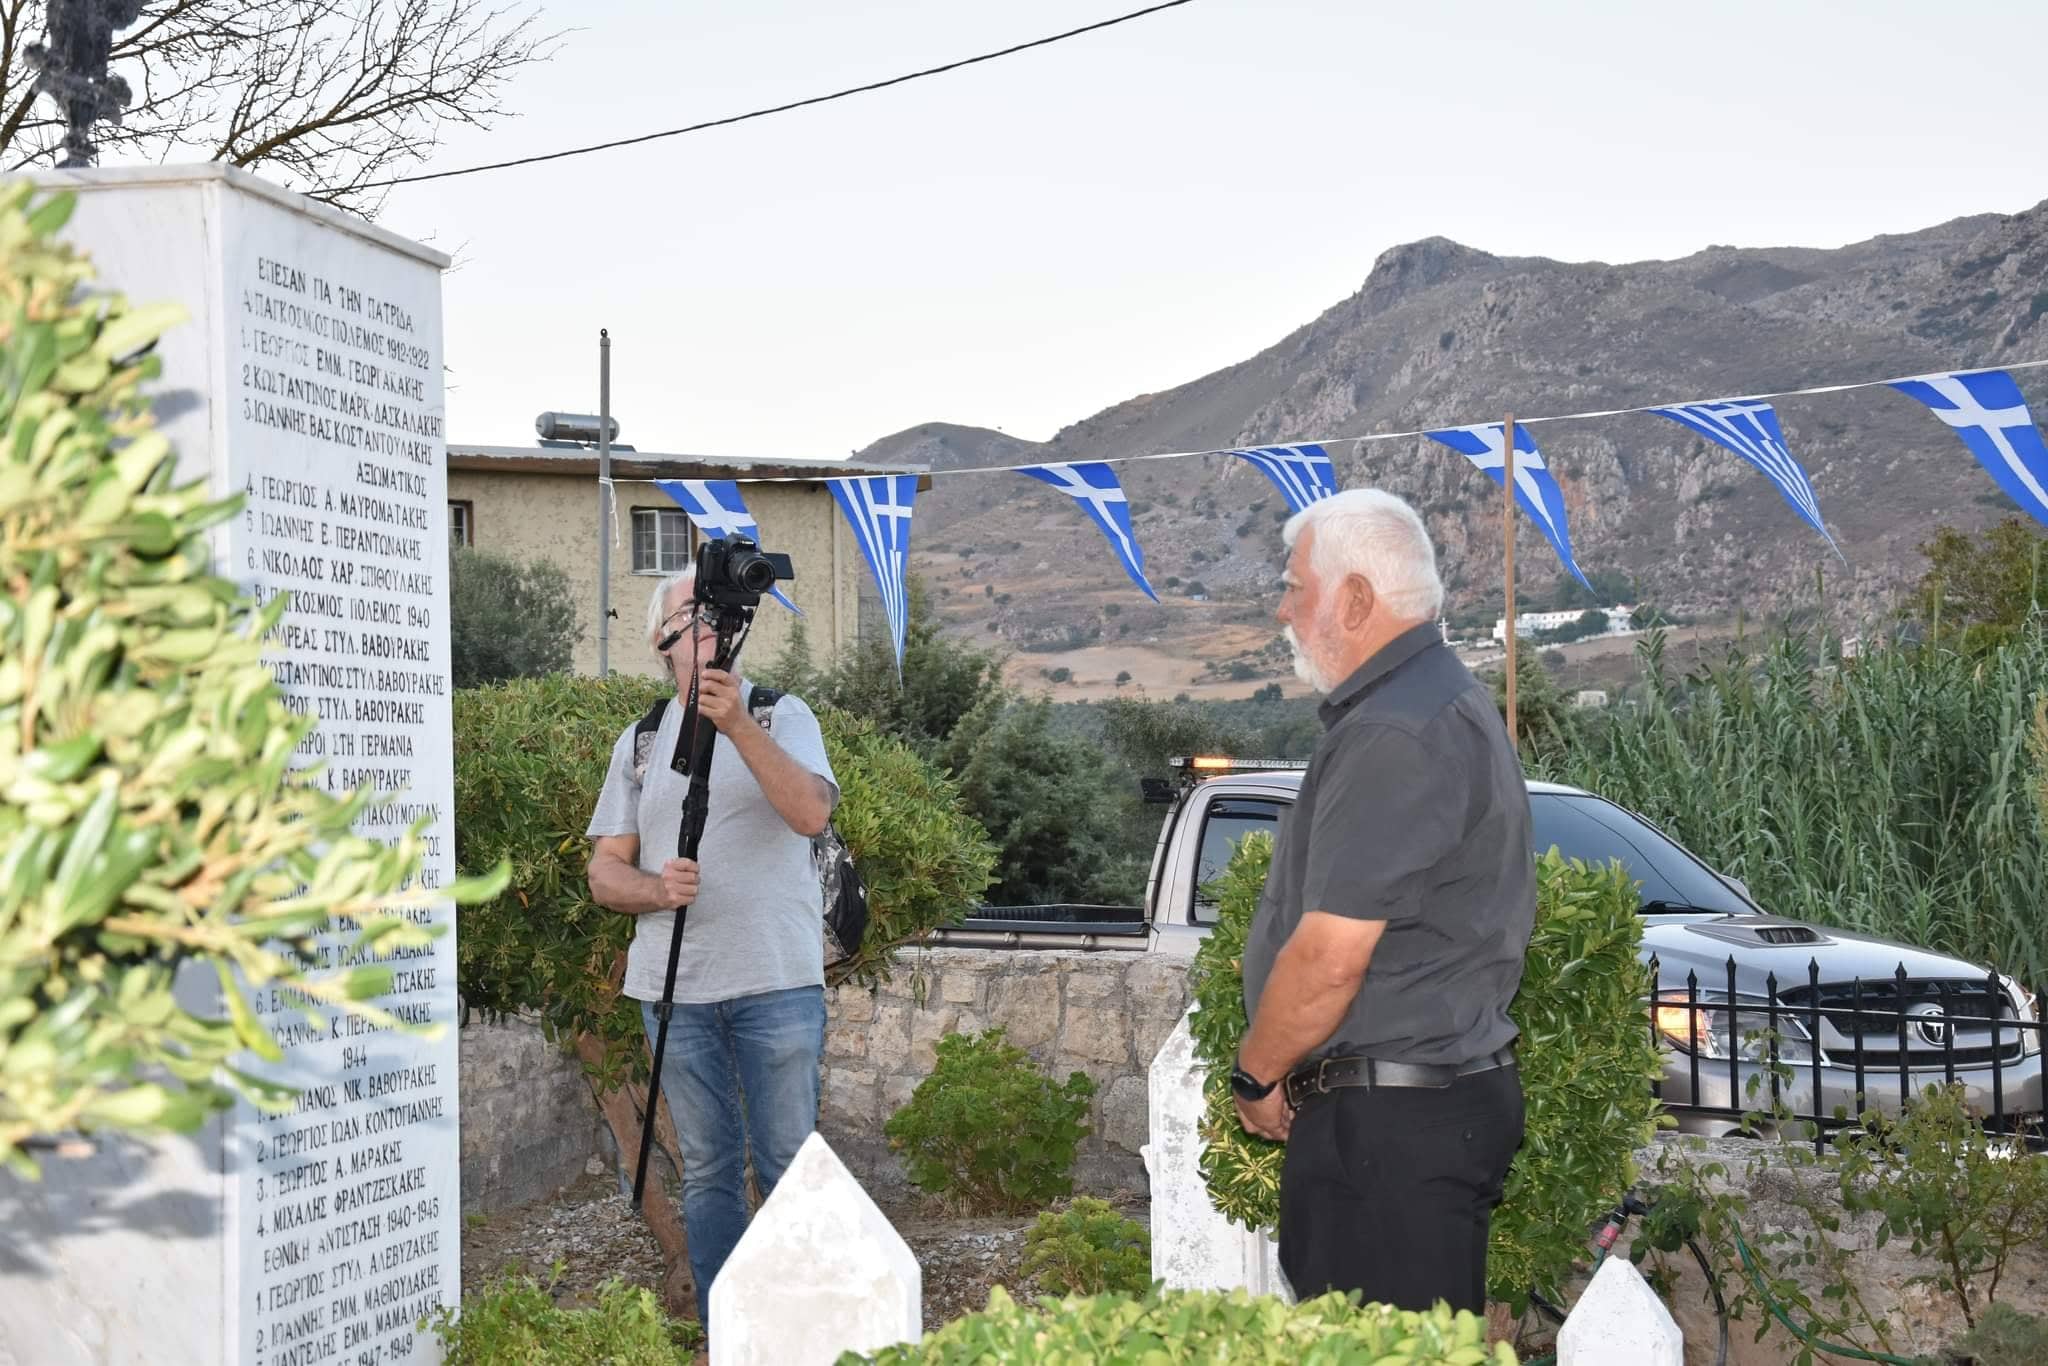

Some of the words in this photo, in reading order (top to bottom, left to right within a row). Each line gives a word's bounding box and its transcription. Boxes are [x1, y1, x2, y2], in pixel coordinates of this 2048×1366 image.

[258, 256, 306, 294] ΕΠΕΣΑΝ
[313, 277, 332, 305] ΓΙΑ
[338, 286, 361, 313] ΤΗΝ
[331, 318, 385, 356] ΠΟΛΕΜΟΣ
[316, 347, 346, 377] ΕΜΜ.
[356, 461, 427, 499] ΑΞΙΩΜΑΤΙΚΟΣ
[262, 475, 318, 509] ΓΕΩΡΓΙΟΣ
[340, 491, 429, 531] ΜΑΥΡΟΜΑΤΑΚΗΣ
[261, 511, 315, 543] ΙΩΑΝΝΗΣ
[321, 521, 333, 545] Ε.
[335, 525, 422, 561] ΠΕΡΑΝΤΩΝΑΚΗΣ
[262, 549, 325, 580] ΝΙΚΟΛΑΟΣ
[350, 597, 401, 625] ΠΟΛΕΜΟΣ
[407, 605, 430, 629] 1940
[324, 630, 359, 656] ΣΤΥΛ.
[361, 632, 430, 662] ΒΑΒΟΥΡΑΚΗΣ
[378, 669, 445, 696] ΒΑΒΟΥΡΑΚΗΣ
[317, 697, 352, 721] ΣΤΥΛ.
[355, 698, 425, 724] ΒΑΒΟΥΡΑΚΗΣ
[332, 733, 354, 757] ΣΤΗ
[361, 733, 414, 758] ΓΕΡΜΑΝΙΑ
[343, 1043, 367, 1070] 1944
[344, 1078, 366, 1104] ΝΙΚ.
[369, 1063, 437, 1098] ΒΑΒΟΥΡΑΚΗΣ
[257, 1139, 269, 1163] 2.
[272, 1123, 328, 1160] ΓΕΩΡΓΙΟΣ
[332, 1115, 363, 1144] ΙΩΑΝ.
[365, 1096, 443, 1136] ΚΟΝΤΟΓΙΑΝΝΗΣ
[272, 1160, 328, 1199] ΓΕΩΡΓΙΟΣ
[335, 1156, 348, 1180] Α.
[351, 1140, 402, 1175] ΜΑΡΑΚΗΣ
[257, 1213, 269, 1238] 4.
[273, 1196, 327, 1233] ΜΙΧΑΛΗΣ
[334, 1166, 426, 1215] ΦΡΑΝΤΖΕΣΚΑΚΗΣ
[264, 1237, 310, 1274] ΕΘΝΙΚΗ
[318, 1214, 381, 1256] ΑΝΤΙΣΤΑΣΗ
[269, 1270, 325, 1312] ΓΕΩΡΓΙΟΣ
[369, 1230, 440, 1276] ΑΛΕΒΥΖΑΚΗΣ
[271, 1305, 325, 1347] ΙΩΑΝΝΗΣ
[332, 1294, 361, 1324] ΕΜΜ.
[363, 1263, 440, 1312] ΜΑΘΙΟΥΔΑΚΗΣ
[344, 1320, 373, 1350] ΕΜΜ.
